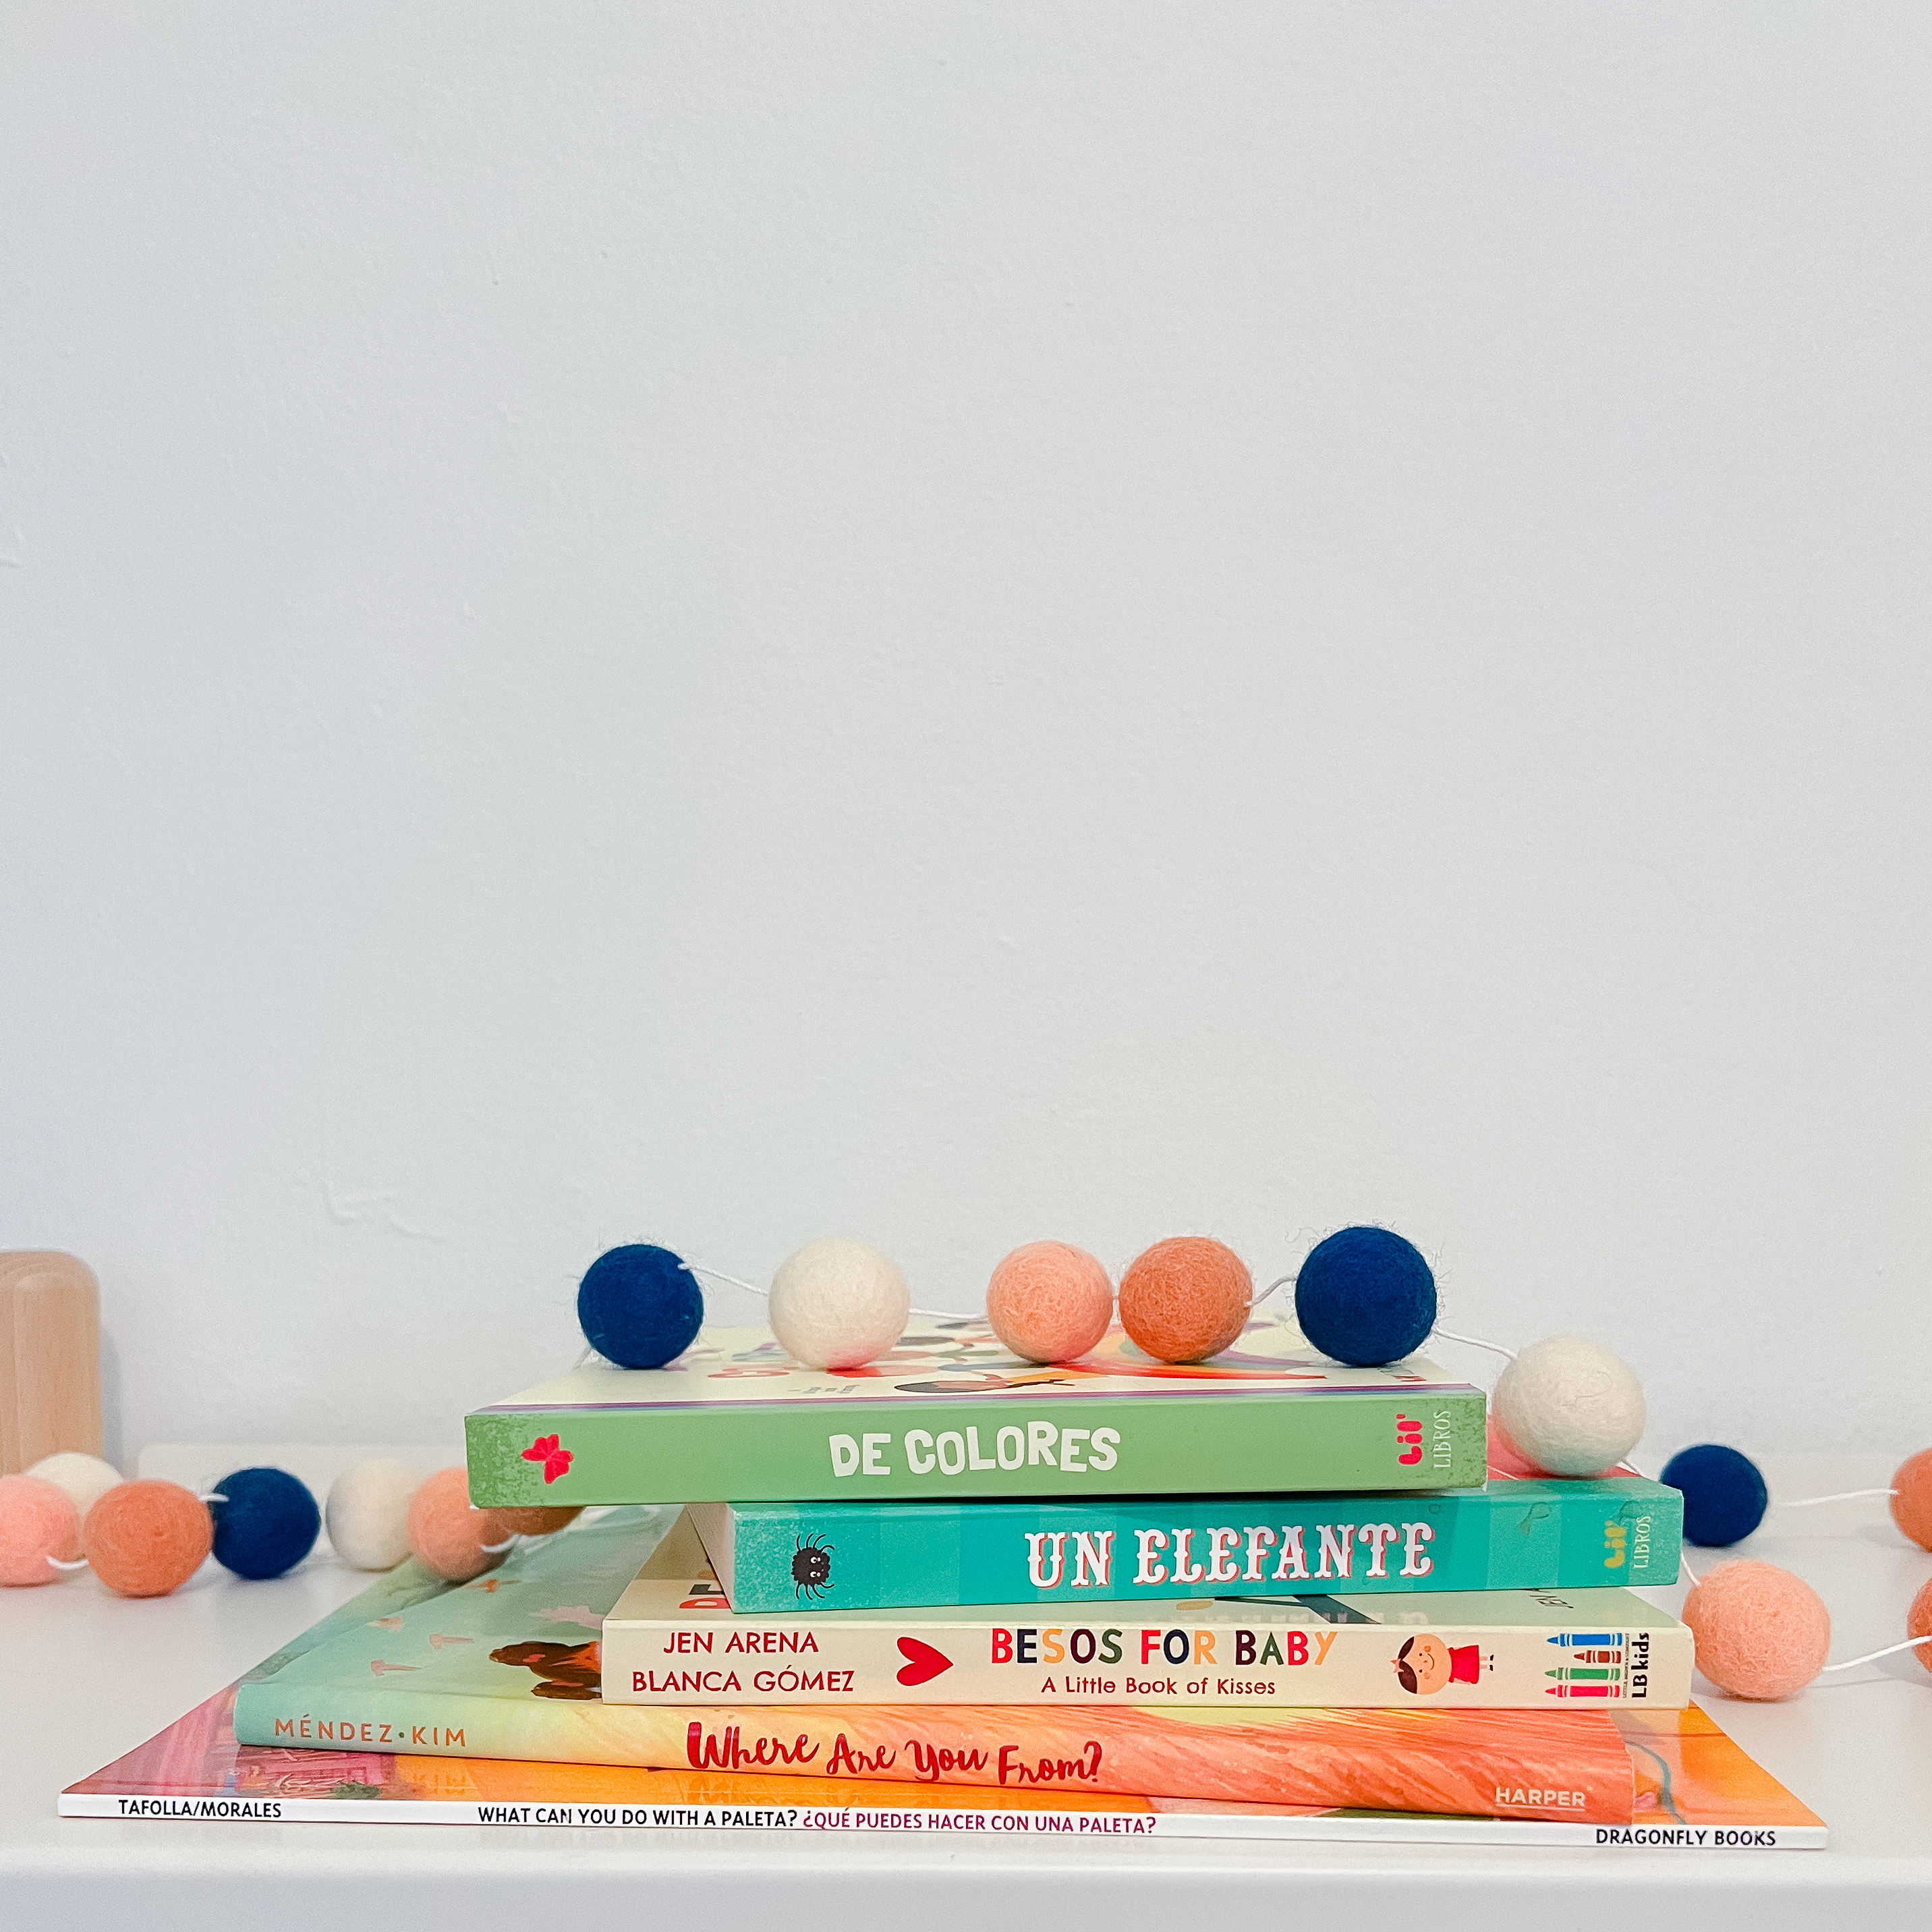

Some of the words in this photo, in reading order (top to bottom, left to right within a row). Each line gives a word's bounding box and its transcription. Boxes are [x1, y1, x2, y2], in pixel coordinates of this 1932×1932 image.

[828, 1433, 891, 1477] DE
[904, 1421, 1120, 1475] COLORES
[1432, 1410, 1452, 1469] LIBROS
[1024, 1530, 1115, 1588] UN
[1132, 1521, 1435, 1585] ELEFANTE
[1632, 1515, 1651, 1570] LIBROS
[664, 1632, 713, 1653] JEN
[725, 1632, 819, 1653] ARENA
[992, 1628, 1123, 1664] BESOS
[1141, 1628, 1217, 1665] FOR
[1235, 1630, 1338, 1666] BABY
[1631, 1633, 1649, 1670] kids
[633, 1670, 741, 1692] BLANCA
[754, 1665, 854, 1692] GÓMEZ
[1041, 1677, 1056, 1693] A
[1065, 1676, 1116, 1694] Little
[1126, 1677, 1177, 1695] Book
[1187, 1677, 1208, 1694] of
[1218, 1678, 1275, 1695] Kisses
[1632, 1674, 1647, 1697] LB
[687, 1721, 820, 1769] Where
[826, 1732, 897, 1775] Are
[904, 1739, 989, 1783] You
[997, 1740, 1103, 1785] From?
[118, 1798, 282, 1819] TAFOLLA/MORALES
[1496, 1787, 1586, 1807] HARPER
[478, 1807, 530, 1825] WHAT
[536, 1808, 573, 1825] CAN
[577, 1809, 616, 1825] YOU
[622, 1810, 648, 1825] DO
[652, 1810, 698, 1827] WITH
[704, 1811, 716, 1825] A
[722, 1809, 797, 1827] PALETA?
[803, 1808, 851, 1831] ¿QUÉ
[855, 1813, 922, 1829] PUEDES
[929, 1814, 985, 1829] HACER
[994, 1815, 1029, 1831] CON
[1035, 1816, 1073, 1831] UNA
[1079, 1816, 1156, 1834] PALETA?
[1597, 1829, 1707, 1844] DRAGONFLY
[1715, 1831, 1775, 1846] BOOKS
